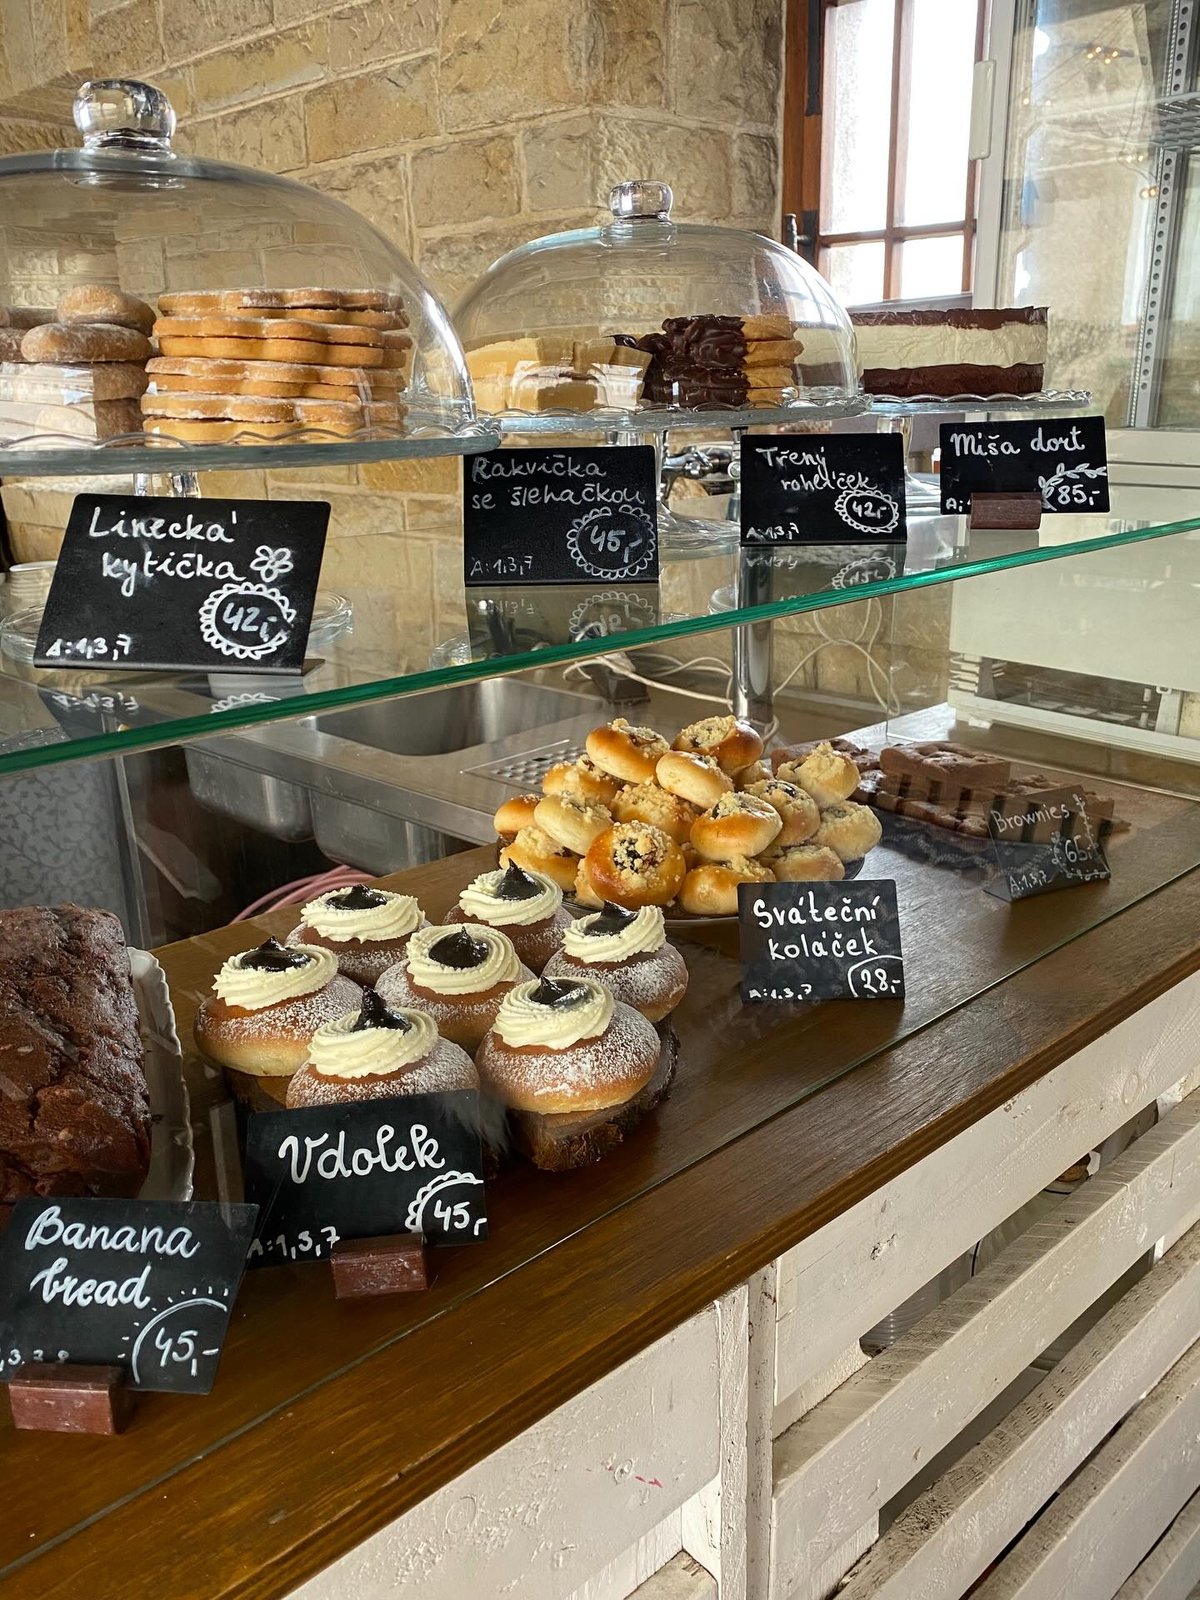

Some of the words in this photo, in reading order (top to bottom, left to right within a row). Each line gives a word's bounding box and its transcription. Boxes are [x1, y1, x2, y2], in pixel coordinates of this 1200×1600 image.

[1030, 425, 1085, 453] dort
[471, 454, 607, 484] Rakvička
[755, 446, 828, 479] Třený
[471, 493, 496, 509] se
[510, 483, 646, 507] šlehačkou
[1057, 484, 1101, 506] 85,-
[589, 525, 643, 563] 45,-
[101, 551, 247, 597] kytička
[990, 803, 1070, 833] Brownies
[753, 890, 880, 928] Sváteční
[768, 927, 878, 960] koláček
[860, 968, 901, 994] 28,-
[278, 1124, 445, 1184] Vdolek
[25, 1205, 200, 1259] Banana
[29, 1256, 152, 1310] bread
[155, 1326, 219, 1377] 45,-
